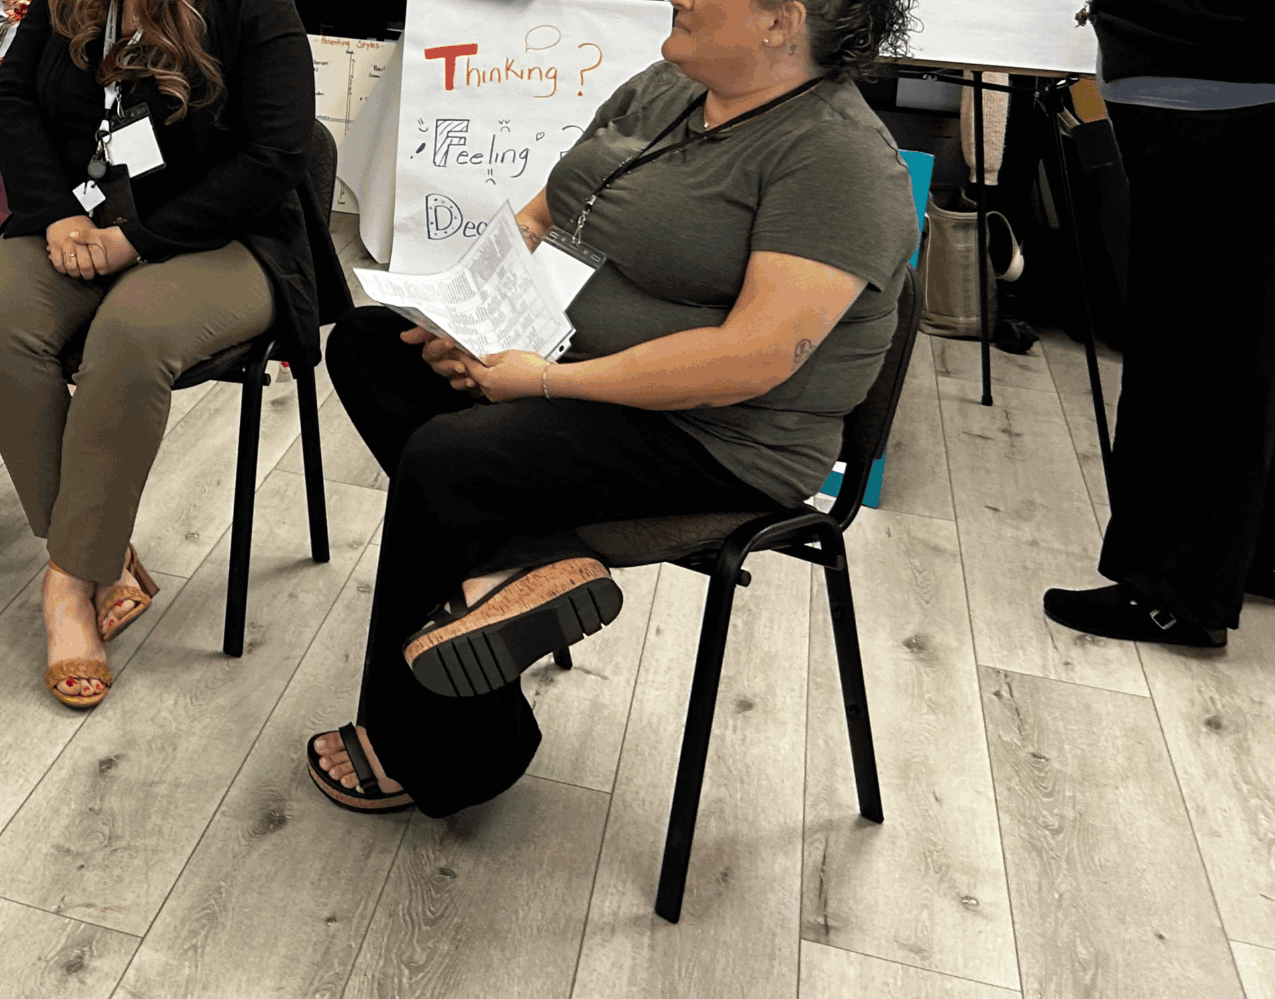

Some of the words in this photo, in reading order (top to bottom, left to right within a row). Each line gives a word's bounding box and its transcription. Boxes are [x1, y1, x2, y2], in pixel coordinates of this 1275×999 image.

[424, 43, 558, 99] Thinking
[577, 42, 603, 97] ?
[433, 119, 531, 178] Feeling
